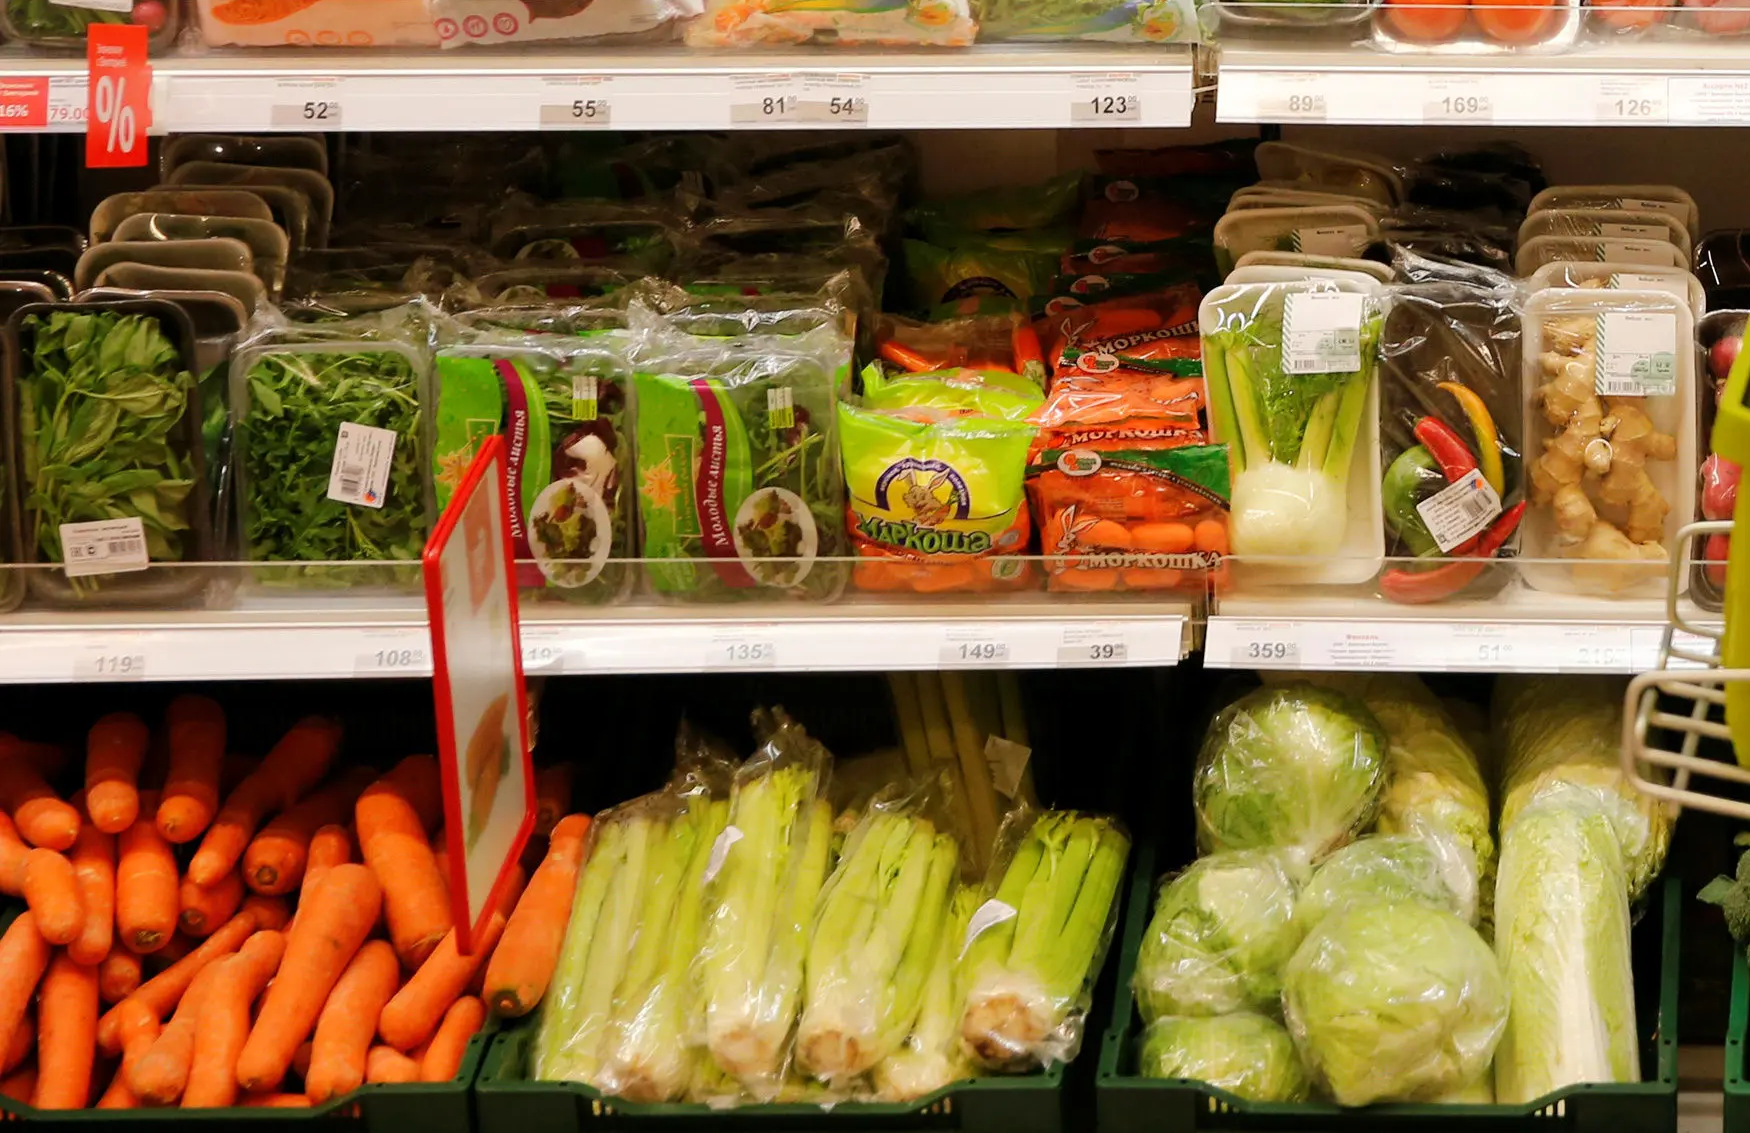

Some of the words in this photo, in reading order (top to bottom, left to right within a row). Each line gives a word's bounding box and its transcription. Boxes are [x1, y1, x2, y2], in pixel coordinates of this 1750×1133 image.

[304, 102, 328, 119] 52
[572, 101, 597, 117] 55
[763, 98, 786, 114] 81
[830, 98, 854, 115] 54
[1091, 96, 1127, 114] 123
[1289, 95, 1314, 111] 89
[1442, 96, 1478, 113] 169
[1615, 99, 1651, 116] 126
[509, 409, 526, 466] листья
[708, 425, 724, 480] листья
[507, 467, 523, 539] Молодые
[703, 481, 729, 546] Молодые
[1090, 552, 1221, 569] МОРКОШКА
[375, 650, 411, 666] 108
[726, 644, 763, 660] 135
[959, 644, 995, 659] 149
[1090, 644, 1114, 659] 39
[1249, 642, 1286, 658] 359
[95, 656, 132, 673] 119
